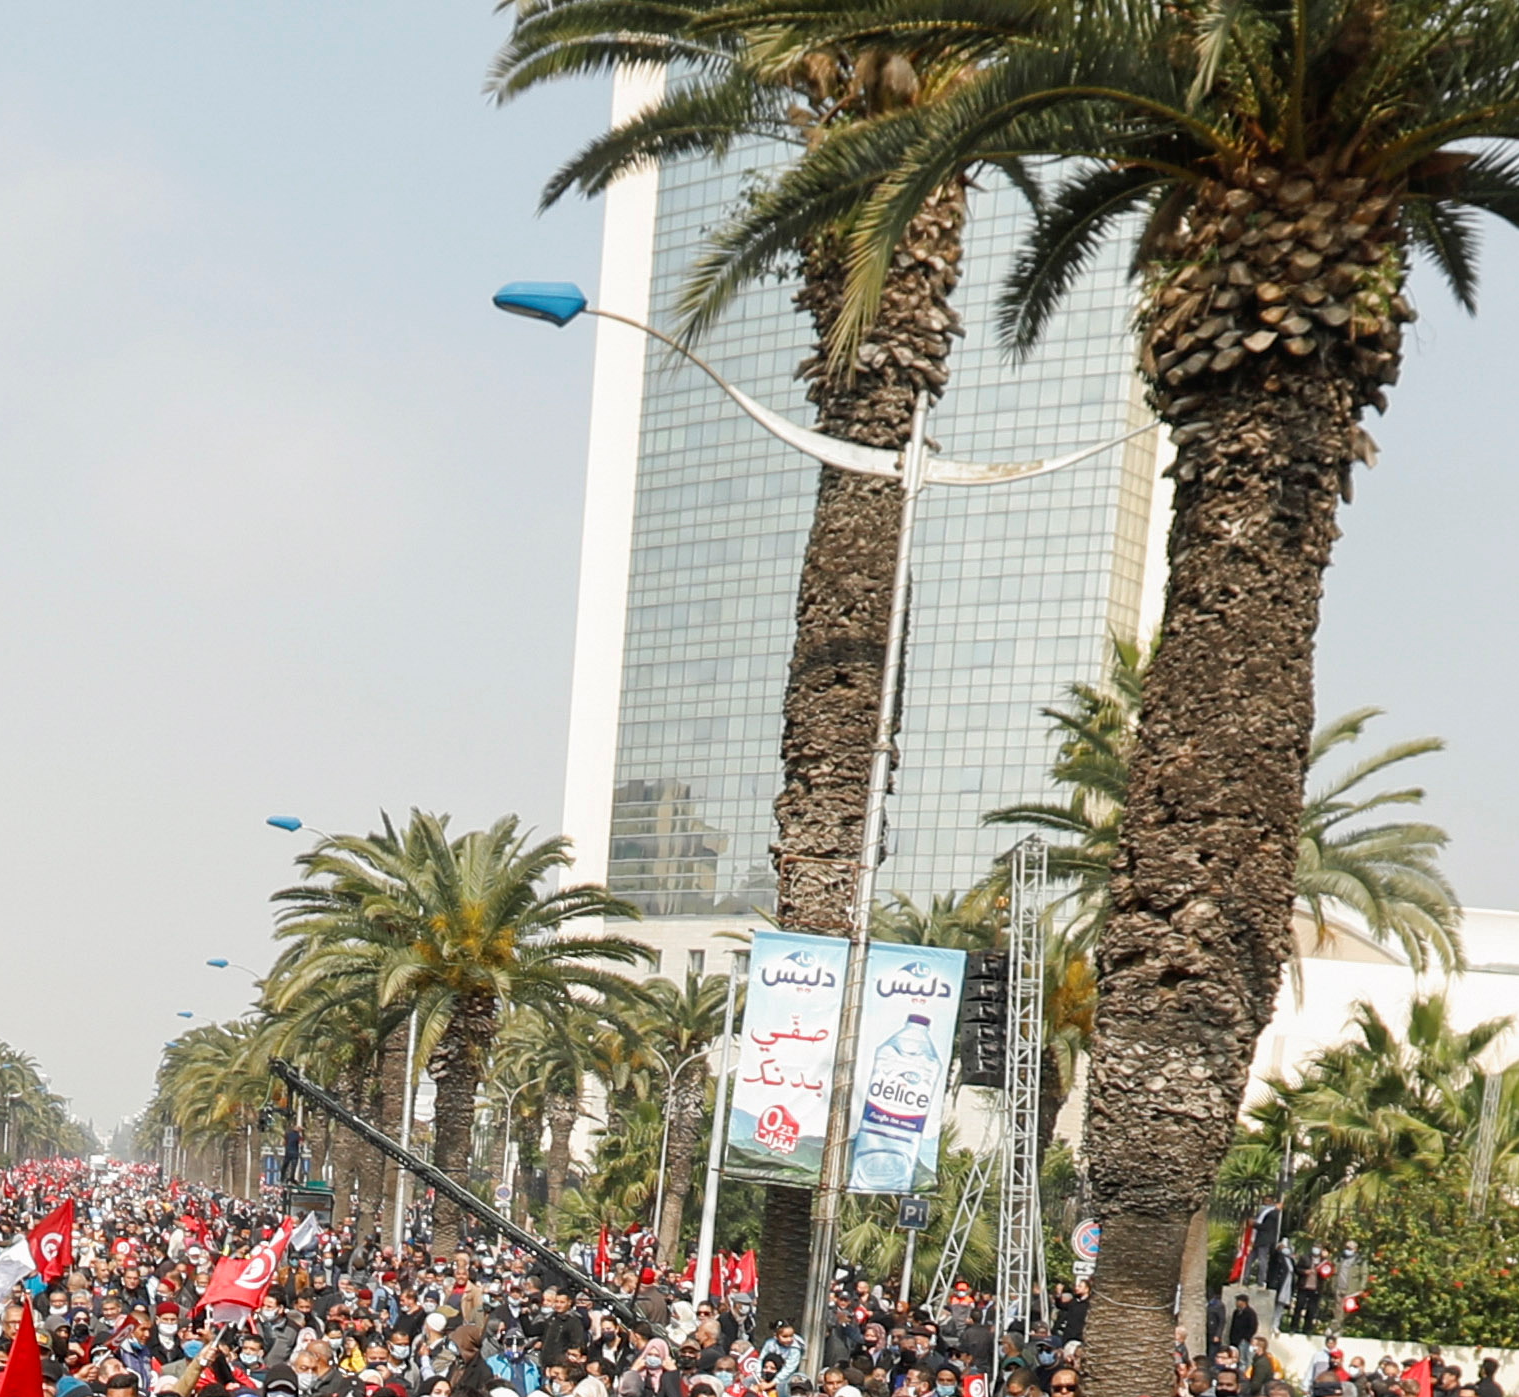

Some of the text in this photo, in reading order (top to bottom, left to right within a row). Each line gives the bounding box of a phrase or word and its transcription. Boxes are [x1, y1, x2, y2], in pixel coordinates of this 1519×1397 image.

[761, 966, 836, 993] دليس
[876, 976, 952, 1004] دليس
[870, 1080, 930, 1109] délice
